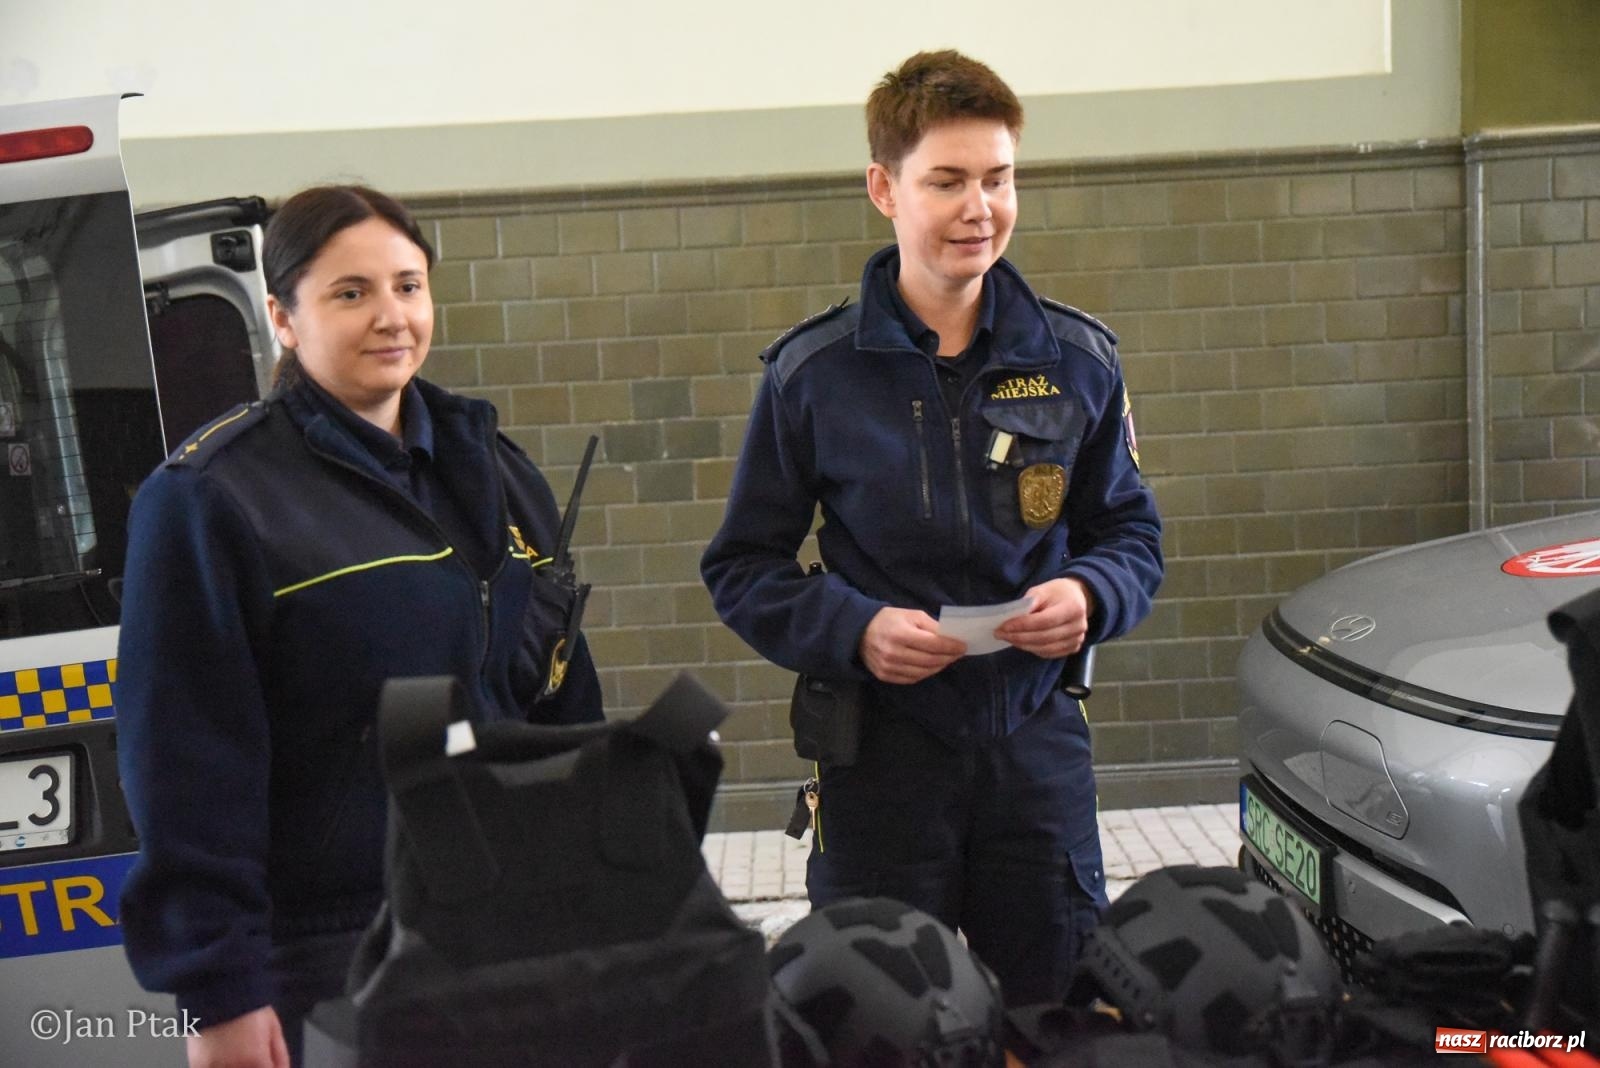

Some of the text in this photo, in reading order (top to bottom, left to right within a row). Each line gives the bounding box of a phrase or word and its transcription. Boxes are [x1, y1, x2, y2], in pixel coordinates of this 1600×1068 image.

[991, 385, 1061, 400] MIEJSKA
[1247, 795, 1317, 897] SRC SE20
[0, 875, 120, 936] TR
